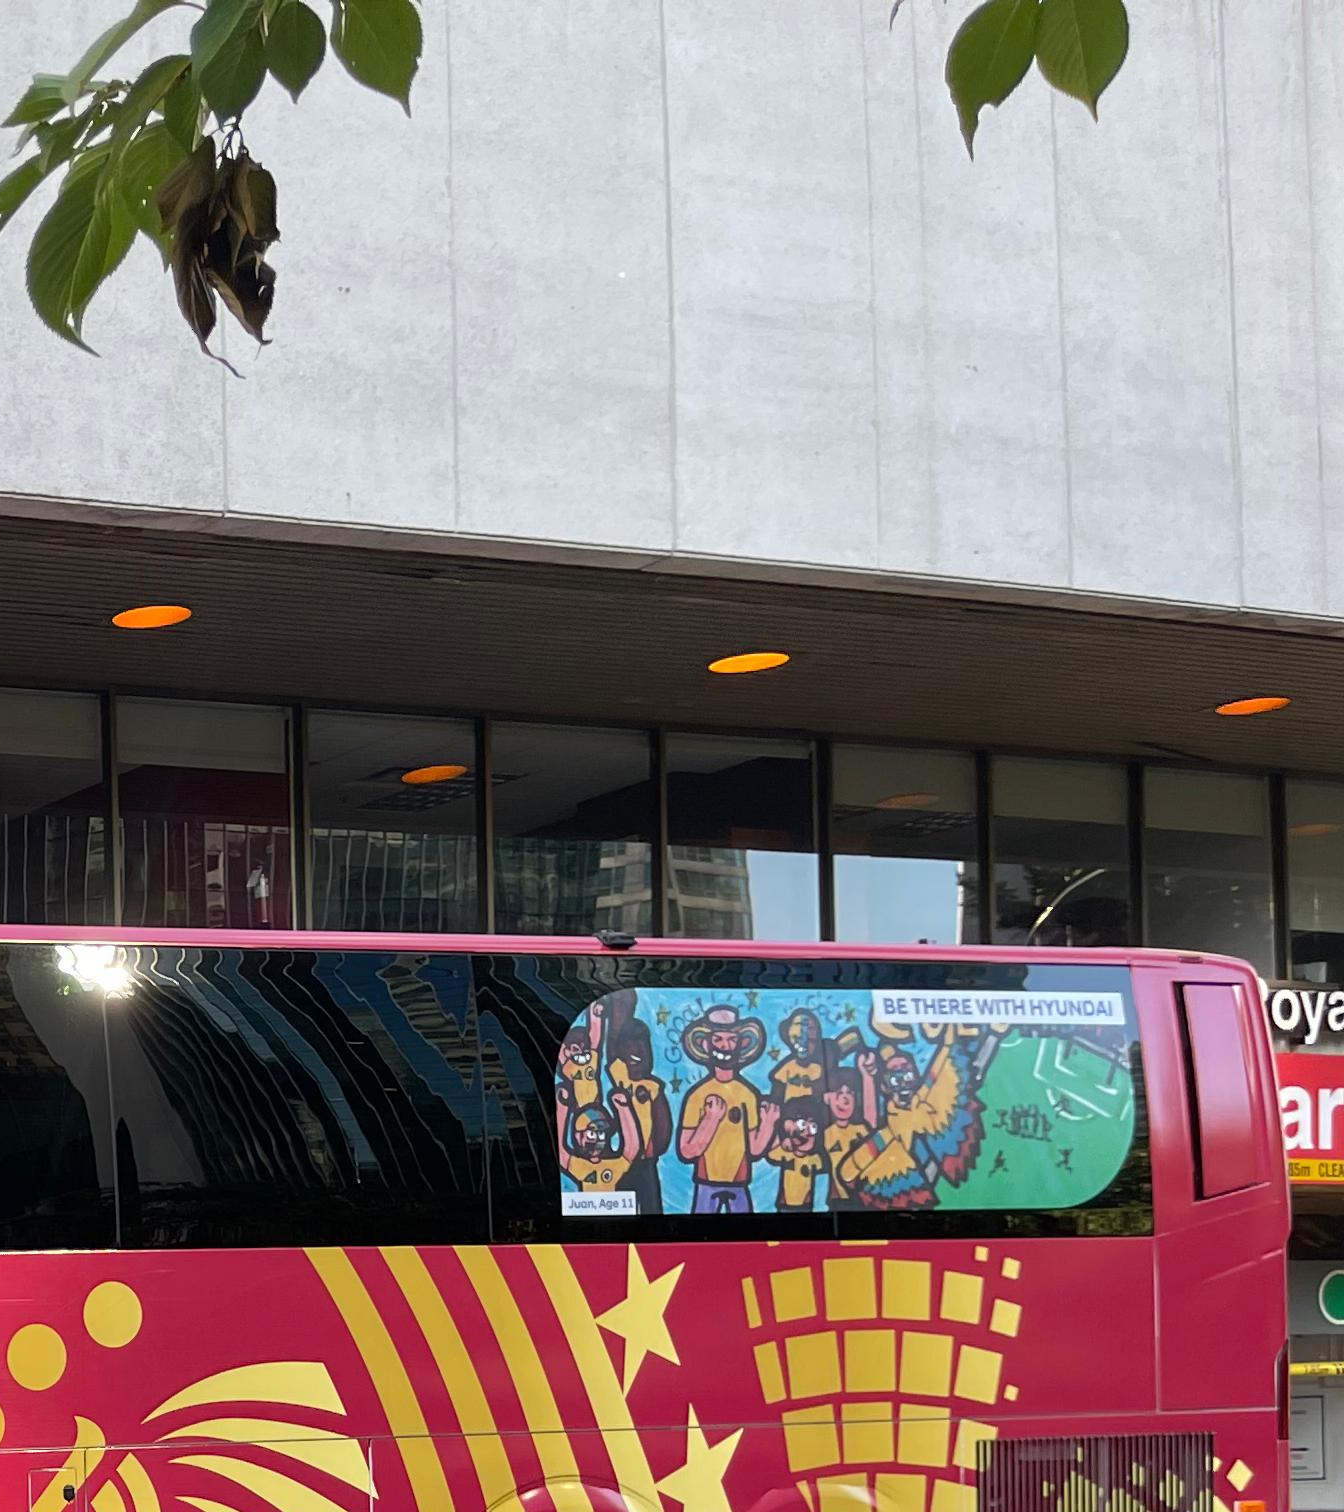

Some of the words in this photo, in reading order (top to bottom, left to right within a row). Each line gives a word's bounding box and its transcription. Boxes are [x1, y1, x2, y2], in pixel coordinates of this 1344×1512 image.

[883, 998, 908, 1015] BE
[911, 998, 972, 1015] THERE
[976, 999, 1026, 1016] WITH
[1030, 1000, 1113, 1017] HYUNDAI
[1260, 977, 1344, 1044] oya
[569, 1199, 598, 1211] Juan,
[599, 1199, 620, 1211] Age
[621, 1199, 634, 1209] 11
